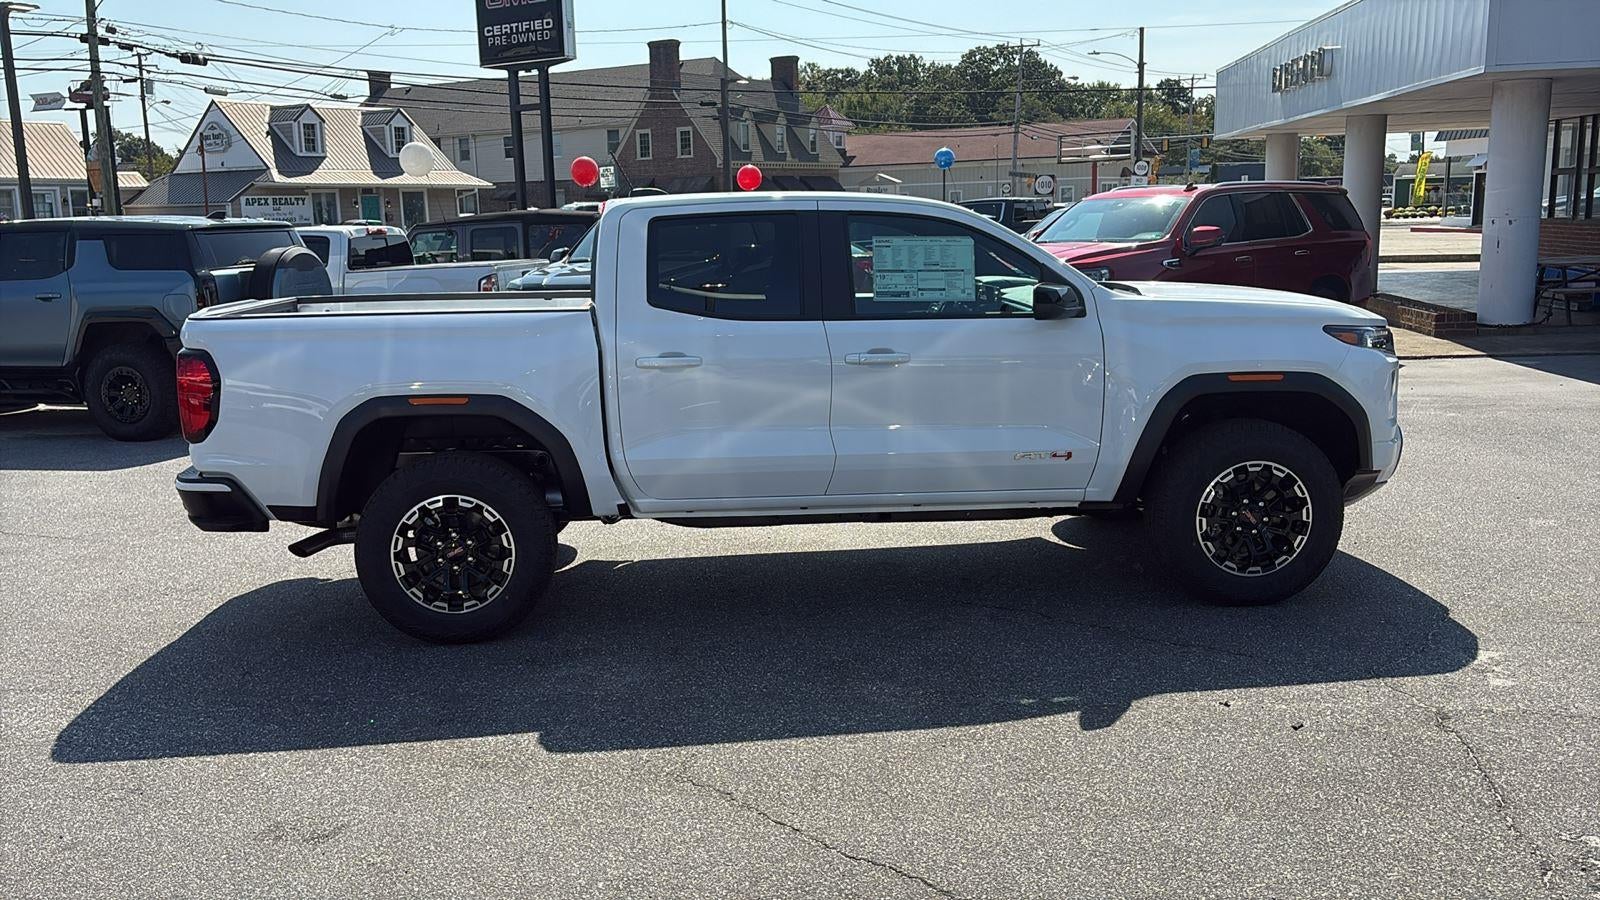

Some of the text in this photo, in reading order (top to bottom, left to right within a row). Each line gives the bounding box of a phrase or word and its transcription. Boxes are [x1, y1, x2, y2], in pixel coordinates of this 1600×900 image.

[484, 19, 553, 36] CERTIFIED
[488, 31, 551, 46] PRE-OWNED
[1037, 180, 1051, 190] 1010
[245, 197, 306, 206] APEX REALTY
